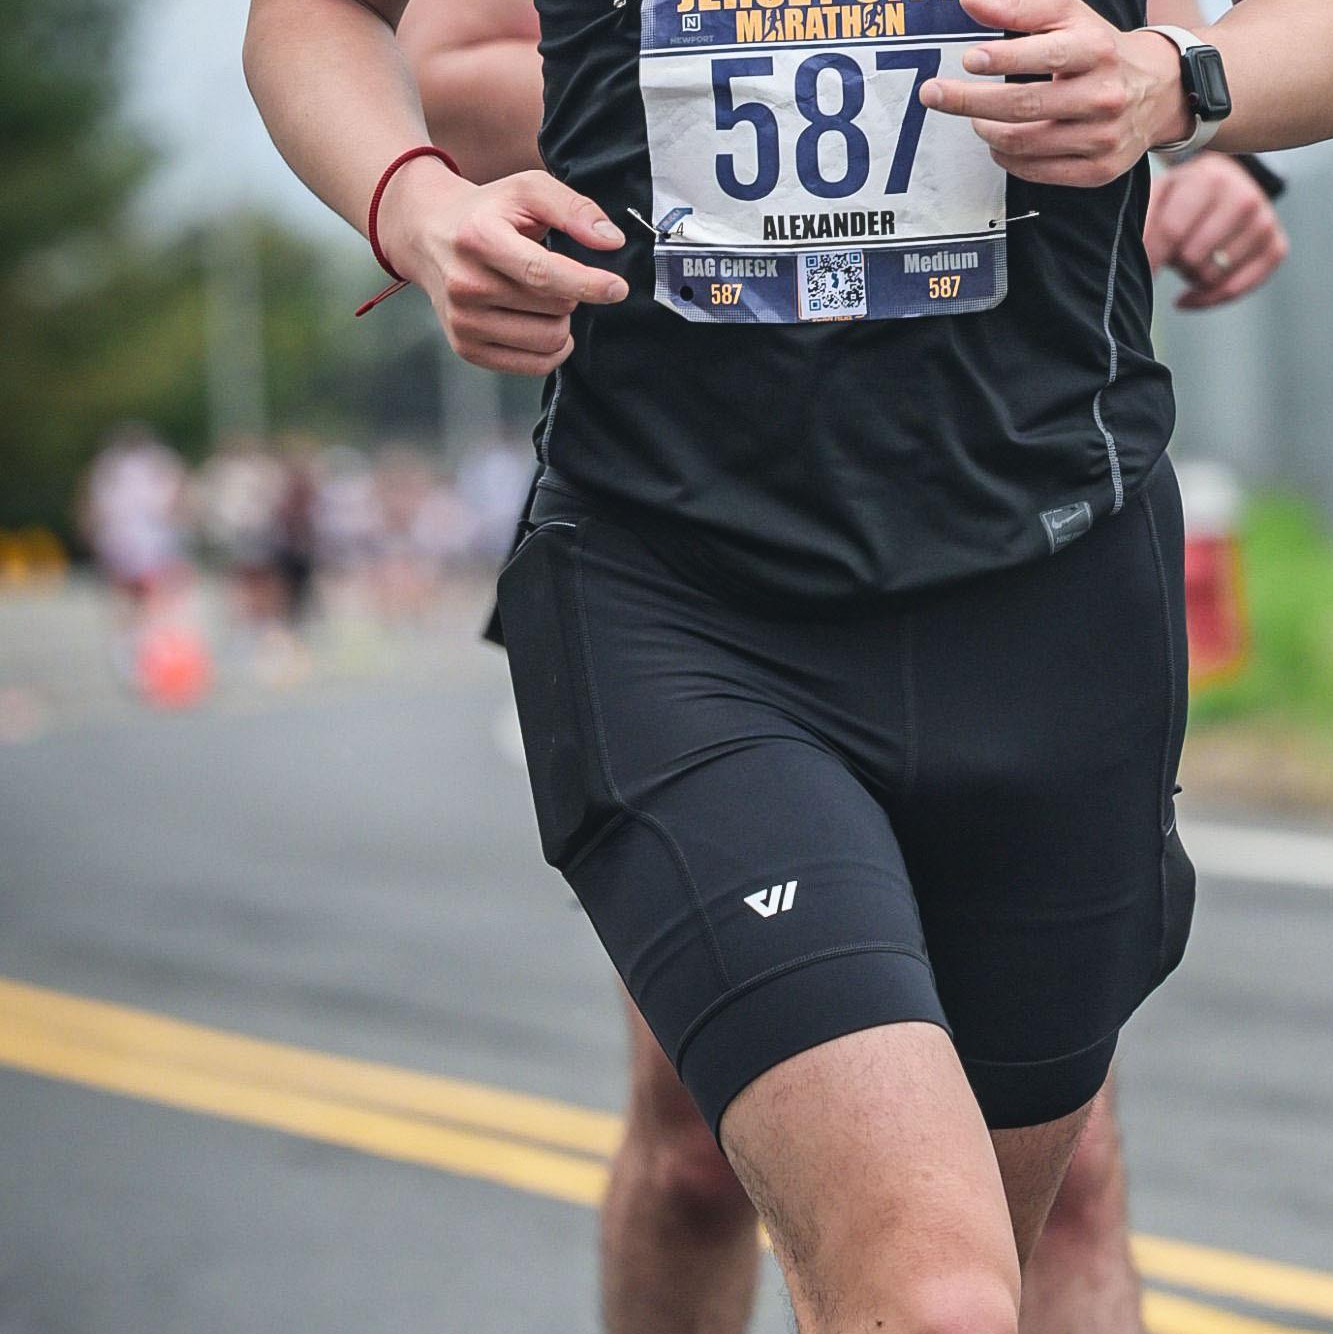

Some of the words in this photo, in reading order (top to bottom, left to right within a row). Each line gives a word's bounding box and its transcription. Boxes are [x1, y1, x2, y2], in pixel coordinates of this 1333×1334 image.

[736, 3, 906, 43] MARATHON
[670, 34, 714, 45] NEWPORT
[711, 48, 942, 202] 587
[677, 221, 684, 236] 4
[763, 210, 896, 241] ALEXANDER
[682, 257, 716, 278] BAG
[723, 258, 779, 278] CHECK
[903, 251, 979, 274] Medium
[710, 283, 743, 306] 587
[928, 275, 961, 299] 587
